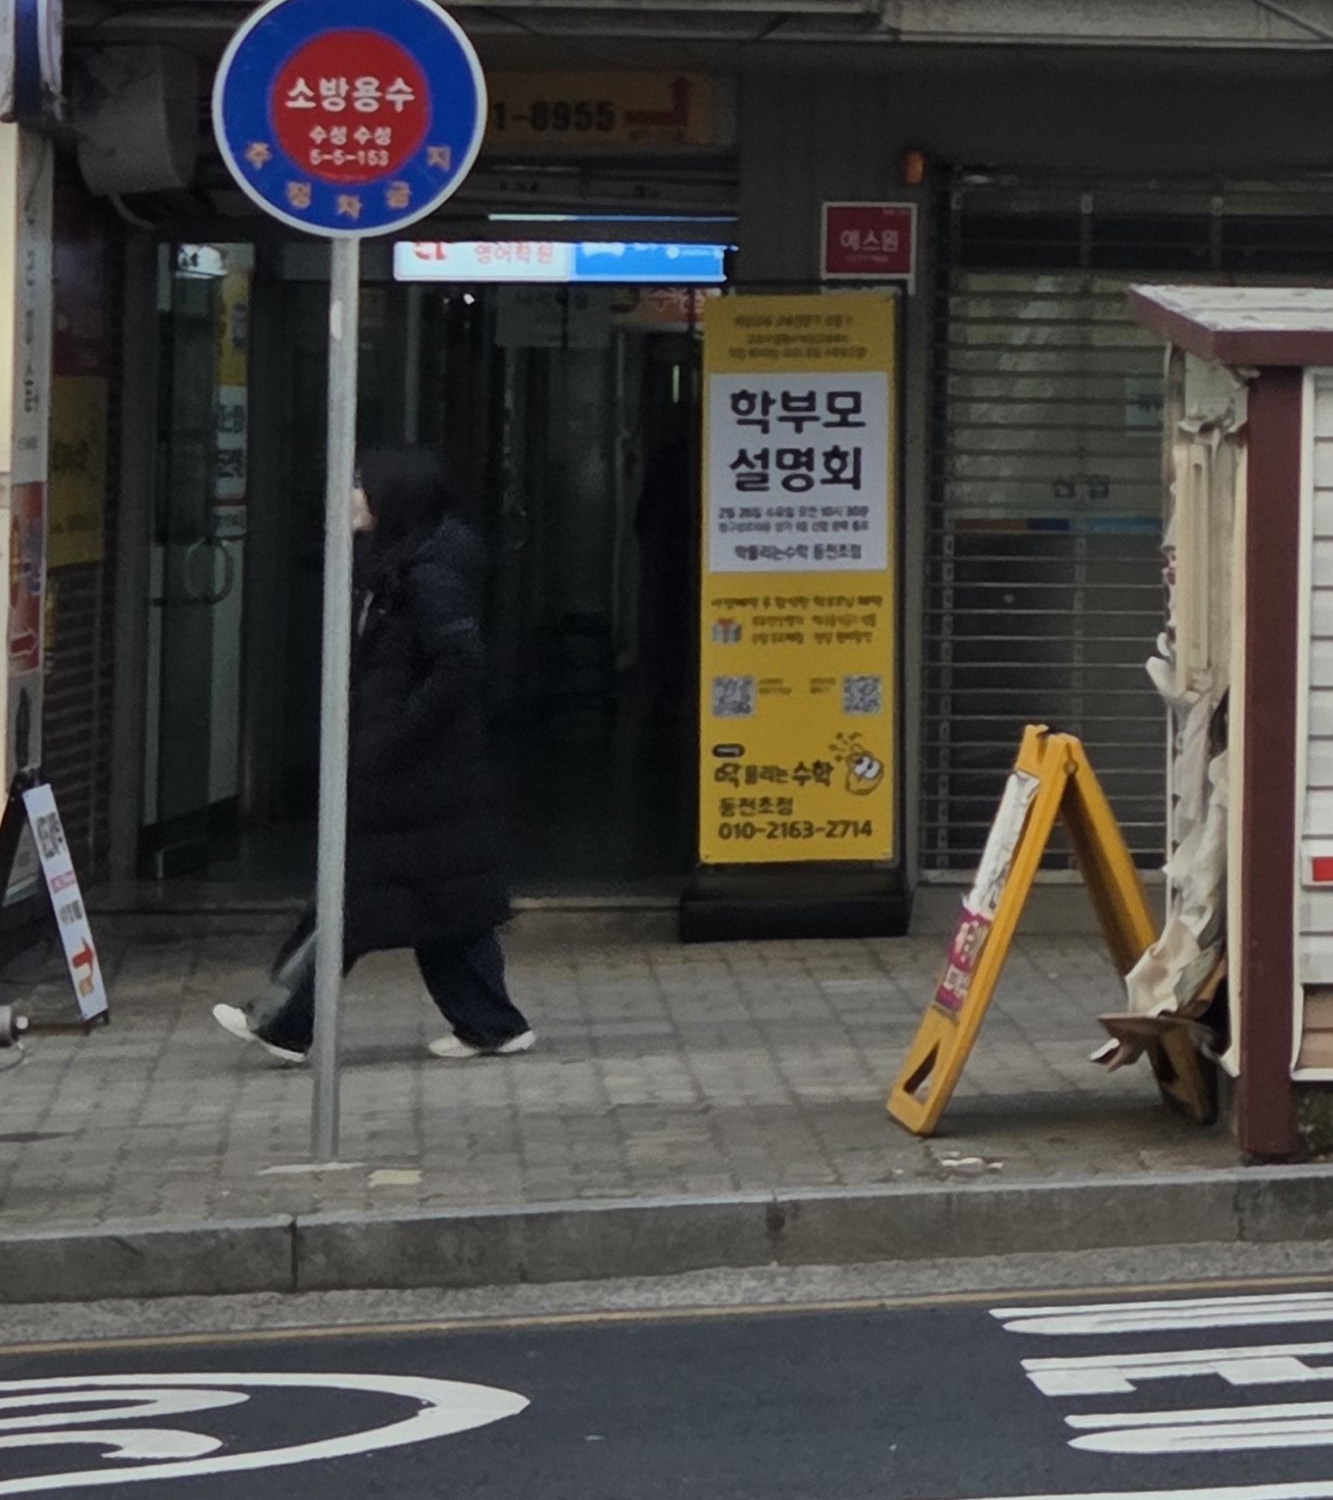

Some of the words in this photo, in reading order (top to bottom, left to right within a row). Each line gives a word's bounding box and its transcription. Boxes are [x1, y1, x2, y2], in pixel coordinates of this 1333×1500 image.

[284, 75, 416, 113] 소방용수
[308, 124, 348, 146] 수성
[352, 124, 392, 147] 수성
[729, 388, 867, 435] 학부모
[729, 444, 863, 493] 설명회
[718, 819, 874, 841] 010-2163-2714
